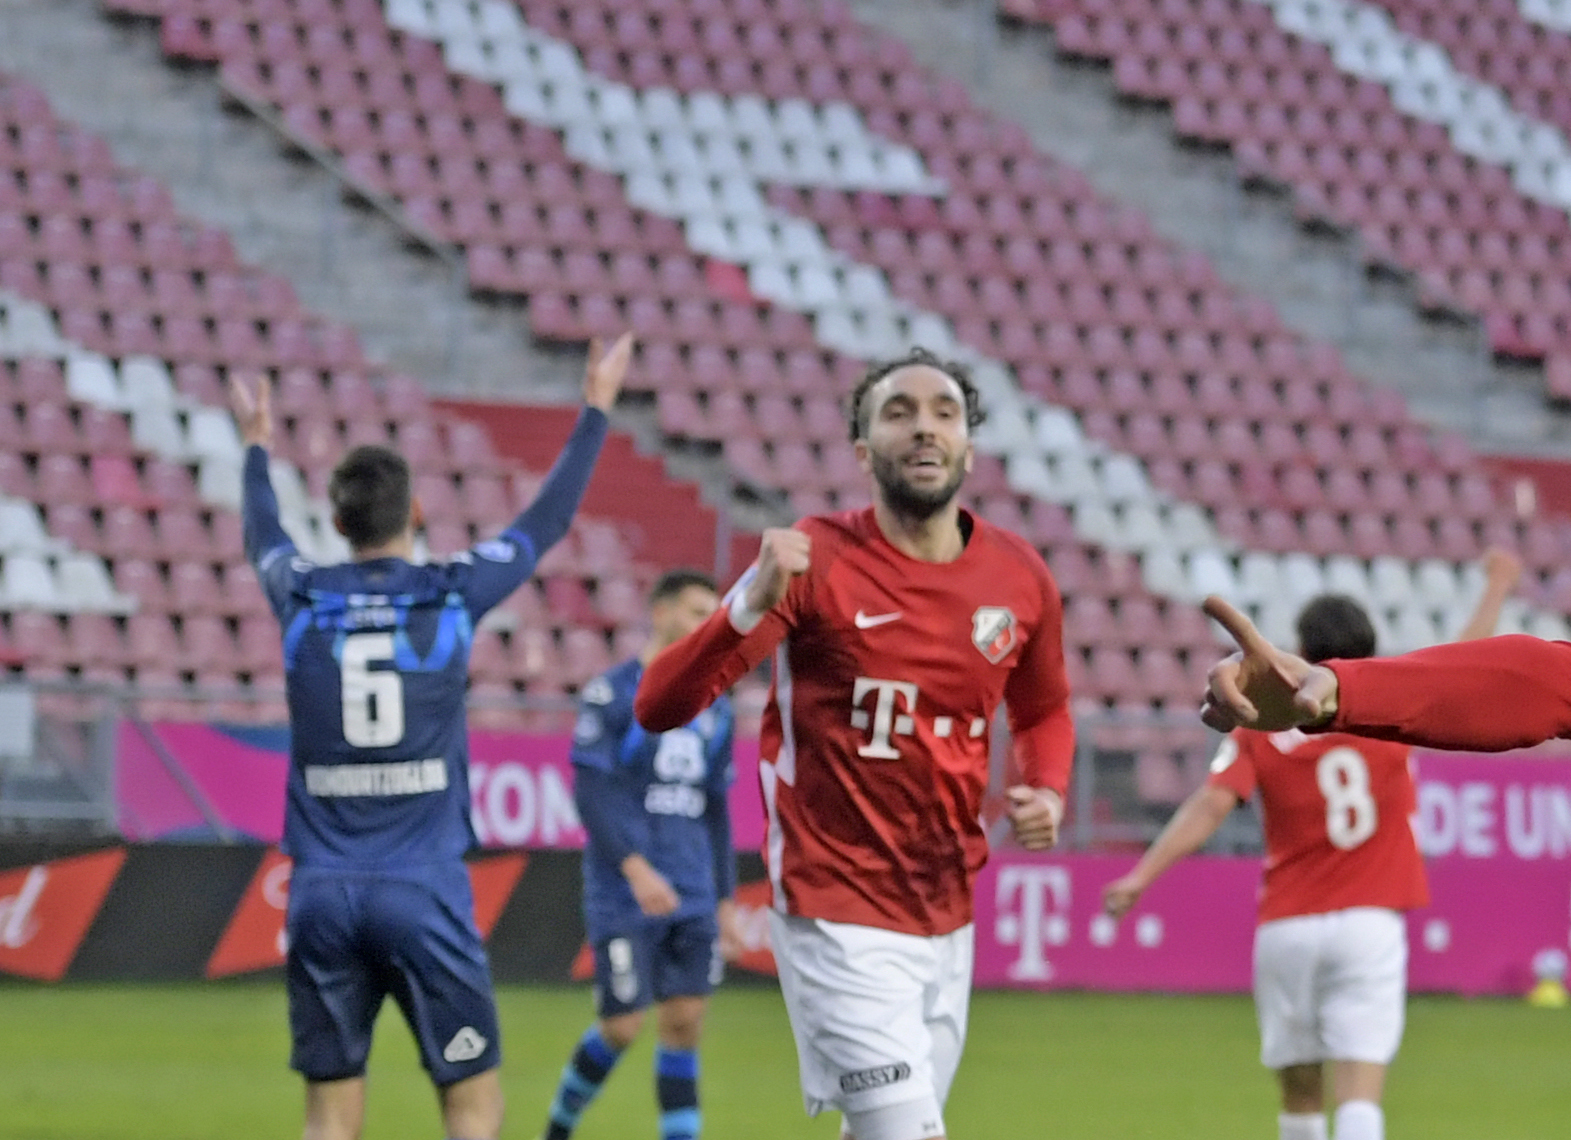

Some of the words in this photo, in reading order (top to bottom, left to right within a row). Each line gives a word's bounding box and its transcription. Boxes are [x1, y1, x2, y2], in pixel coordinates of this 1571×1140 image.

[341, 632, 405, 748] 6
[852, 677, 918, 760] T
[1316, 746, 1378, 850] 8
[995, 865, 1071, 981] T
